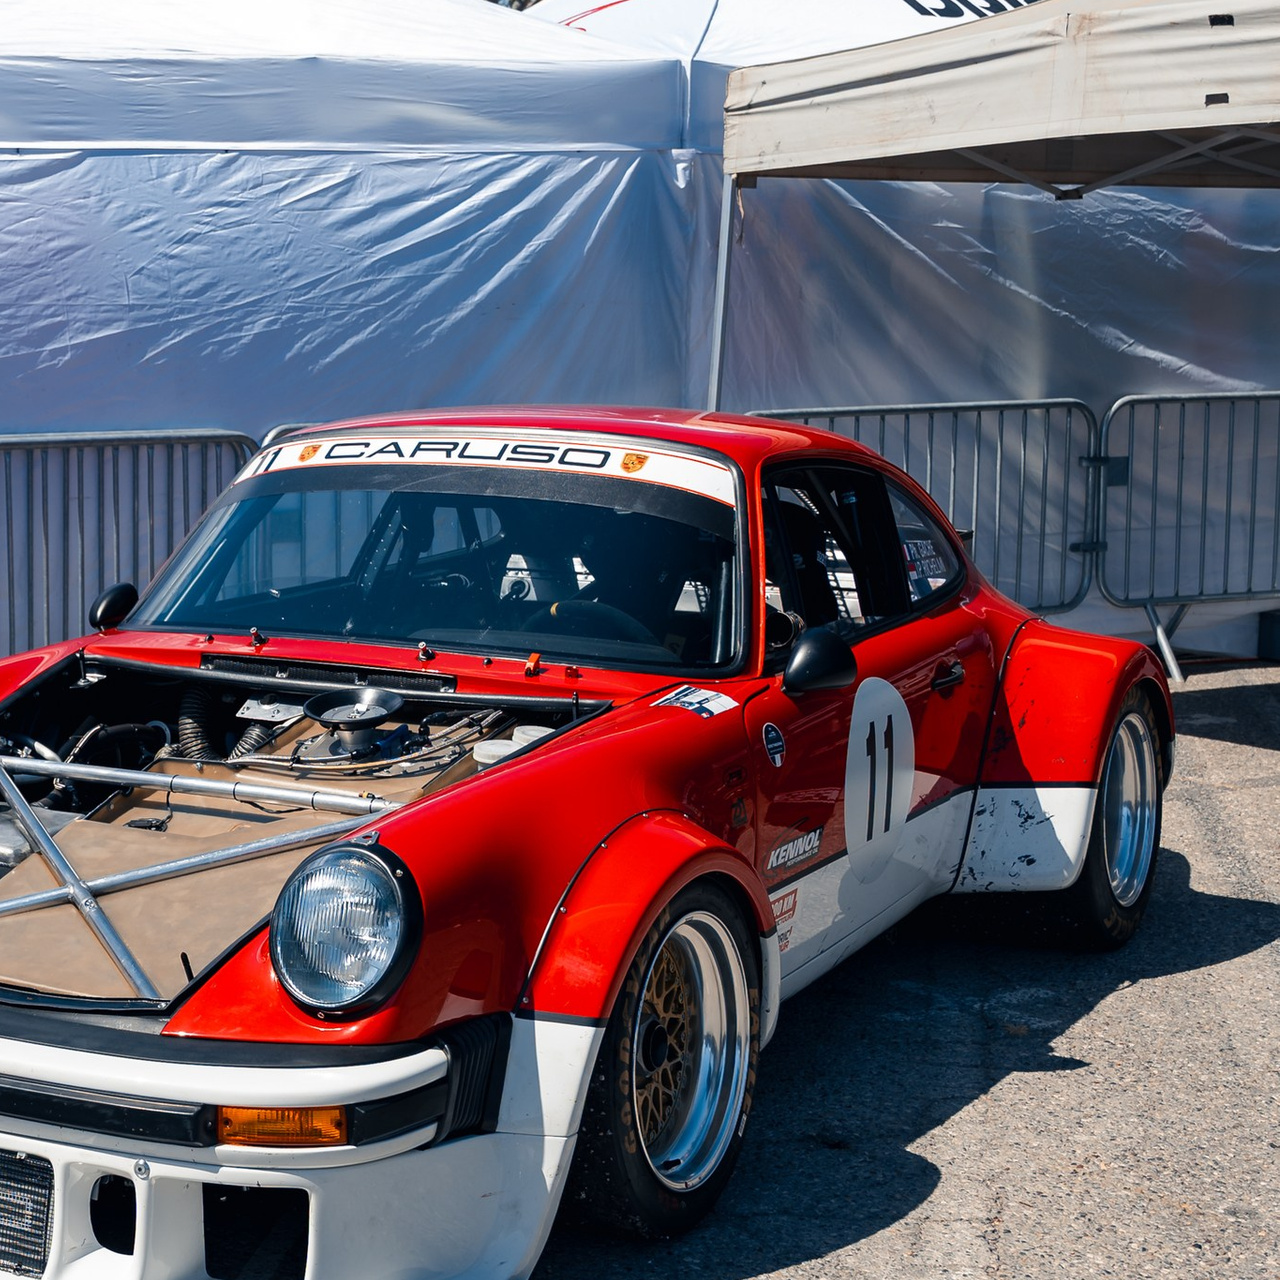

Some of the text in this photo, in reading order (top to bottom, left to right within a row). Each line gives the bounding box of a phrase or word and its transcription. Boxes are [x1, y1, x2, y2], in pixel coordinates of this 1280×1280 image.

[324, 441, 611, 468] CARUSO
[865, 714, 894, 842] 11
[767, 828, 821, 870] KENNOL
